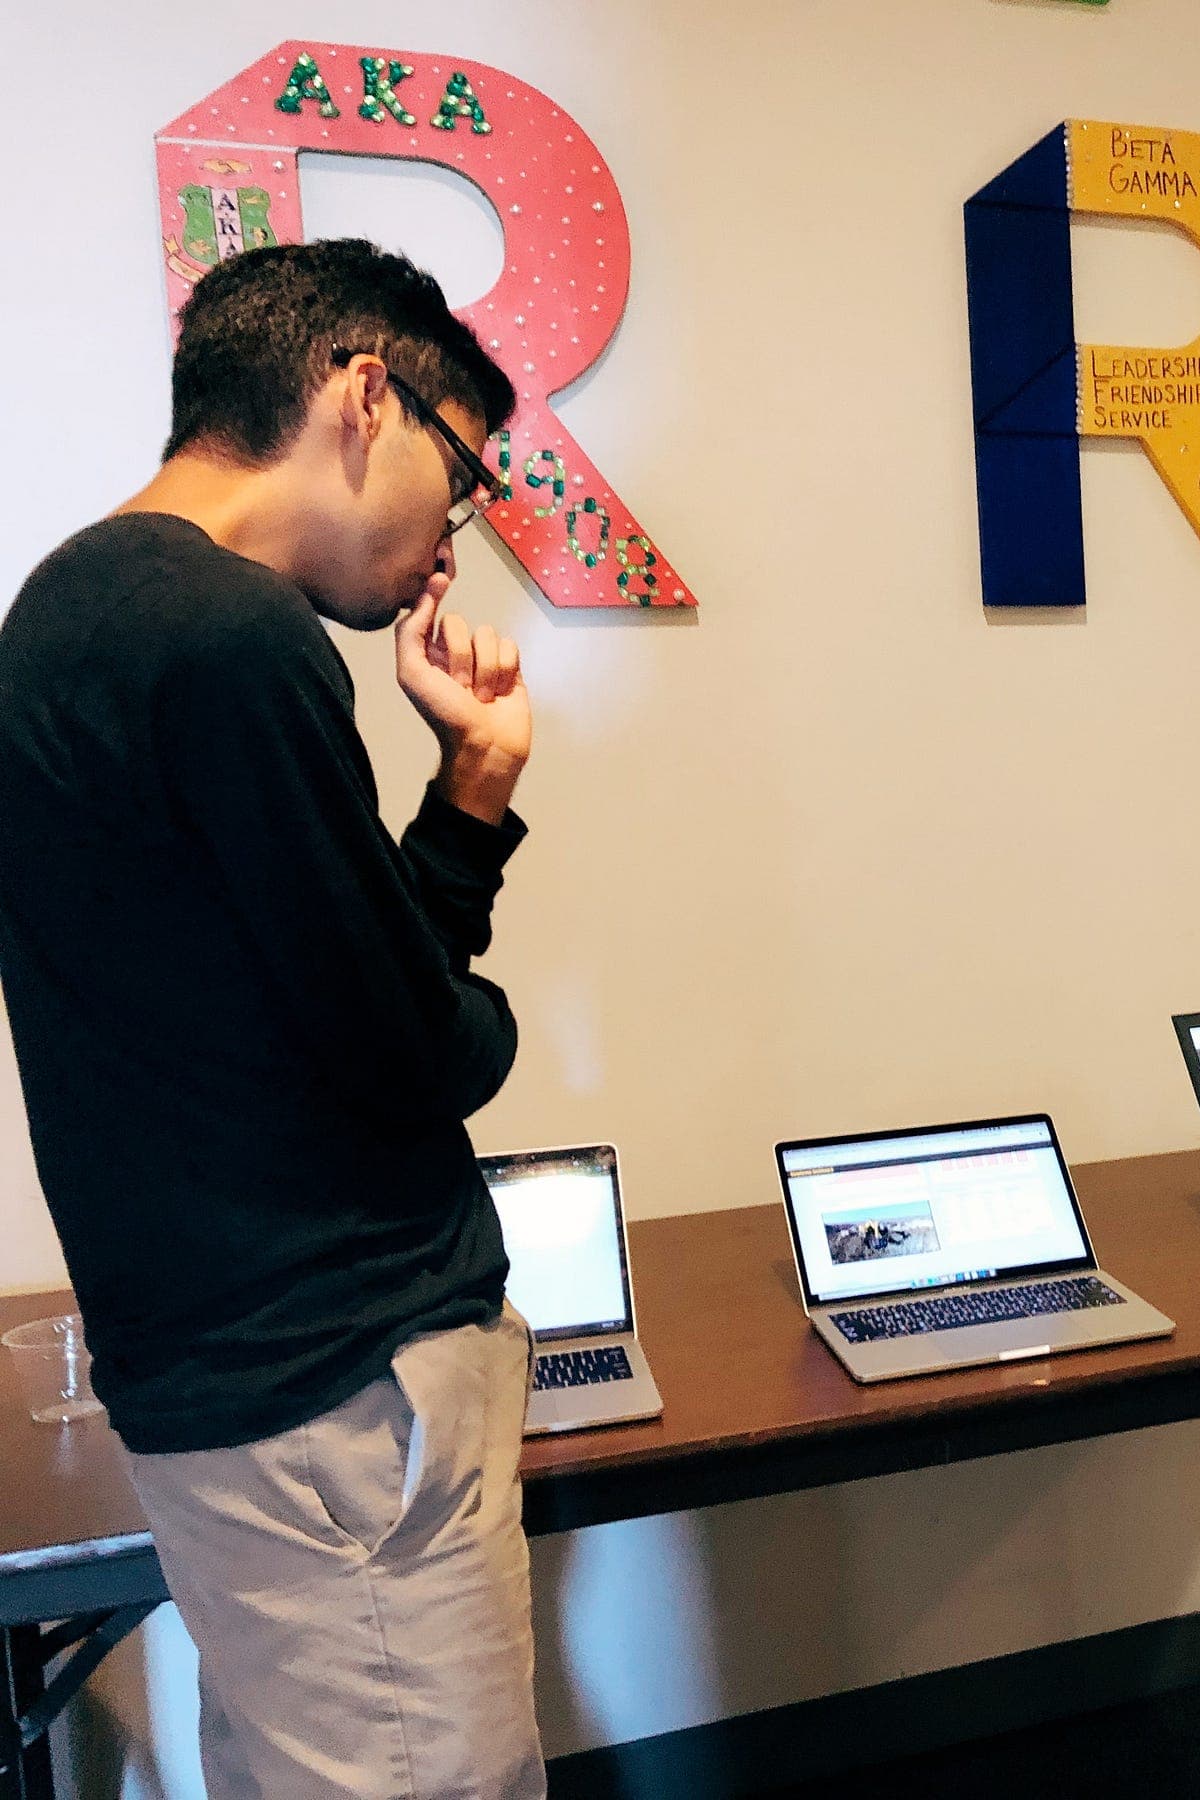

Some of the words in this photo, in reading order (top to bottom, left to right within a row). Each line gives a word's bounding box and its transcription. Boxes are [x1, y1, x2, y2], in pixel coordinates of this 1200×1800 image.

[273, 51, 492, 135] AKA
[1111, 128, 1175, 165] BETA
[1109, 163, 1198, 197] GAMMA
[1094, 405, 1172, 428] SERVICE
